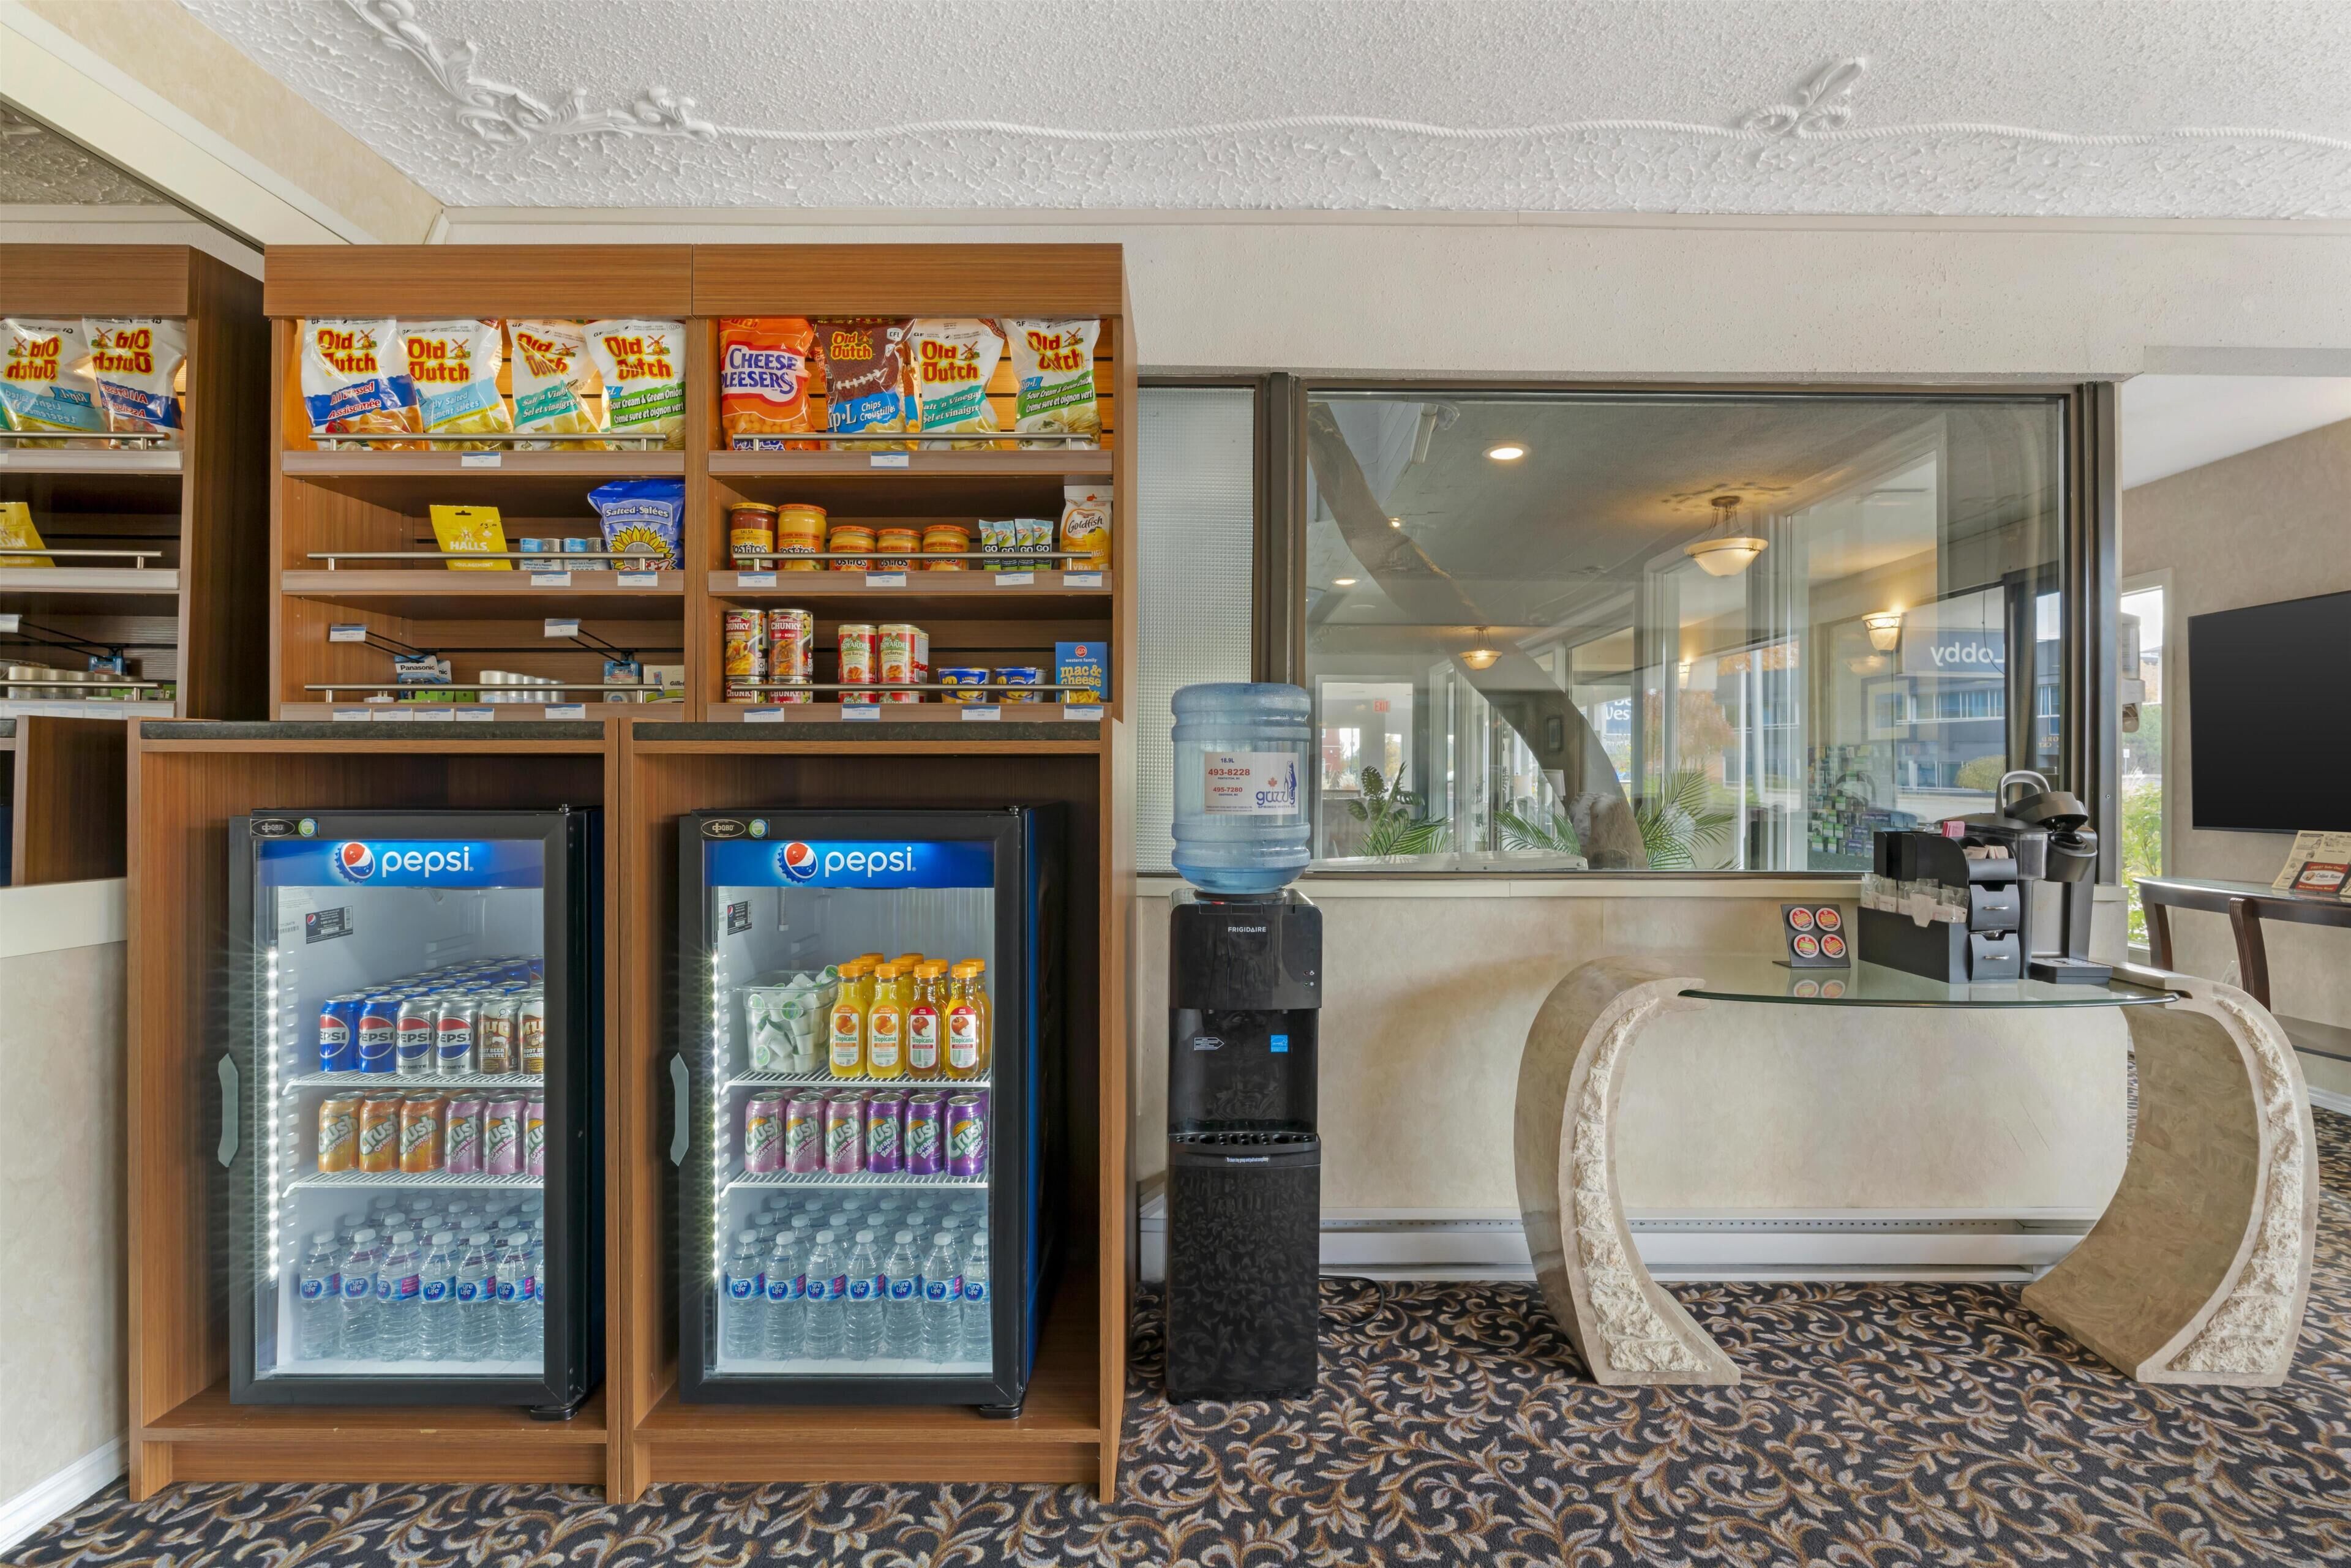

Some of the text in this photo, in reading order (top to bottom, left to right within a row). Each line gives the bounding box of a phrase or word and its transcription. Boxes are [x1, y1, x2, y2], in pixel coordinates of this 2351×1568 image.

[317, 330, 354, 350] Old
[517, 333, 553, 353] Old
[604, 336, 643, 357] Old
[832, 331, 858, 345] Old
[1027, 331, 1061, 351] Old
[407, 338, 446, 360] Old
[831, 344, 872, 360] Dutch
[921, 340, 957, 360] Old
[408, 361, 470, 381] Dutch
[525, 354, 569, 377] Dutch
[617, 358, 672, 381] Dutch
[922, 361, 978, 383] Dutch
[445, 391, 468, 405] Salted
[621, 396, 640, 407] Cream
[647, 391, 665, 403] Green
[665, 387, 683, 398] Onion
[1026, 390, 1040, 401] Sour
[1040, 388, 1057, 399] Cream
[1026, 389, 1093, 413] Crème sure et oignon vert
[523, 399, 576, 418] Sel et vinaigre
[613, 402, 684, 424] Crème sure et oignon vert
[859, 405, 896, 421] Croustilles
[861, 400, 882, 412] Chips
[936, 410, 945, 420] et
[945, 404, 980, 418] vinaigre
[606, 505, 670, 518] Salted Salées
[1068, 515, 1103, 534] Goldfish
[450, 541, 488, 551] HALLS
[841, 642, 871, 651] BOYARDEE
[1060, 665, 1102, 678] mac &
[1060, 676, 1101, 687] cheese
[1374, 700, 1389, 711] EXIT
[381, 846, 471, 878] pepsi
[825, 846, 913, 877] pepsi
[407, 1132, 433, 1152] Orange
[866, 1117, 900, 1154] Crush
[904, 1118, 940, 1157] Crush
[945, 1118, 984, 1158] Crush
[348, 1278, 365, 1288] Pure
[808, 1281, 822, 1289] Pure
[929, 1281, 944, 1290] Pure
